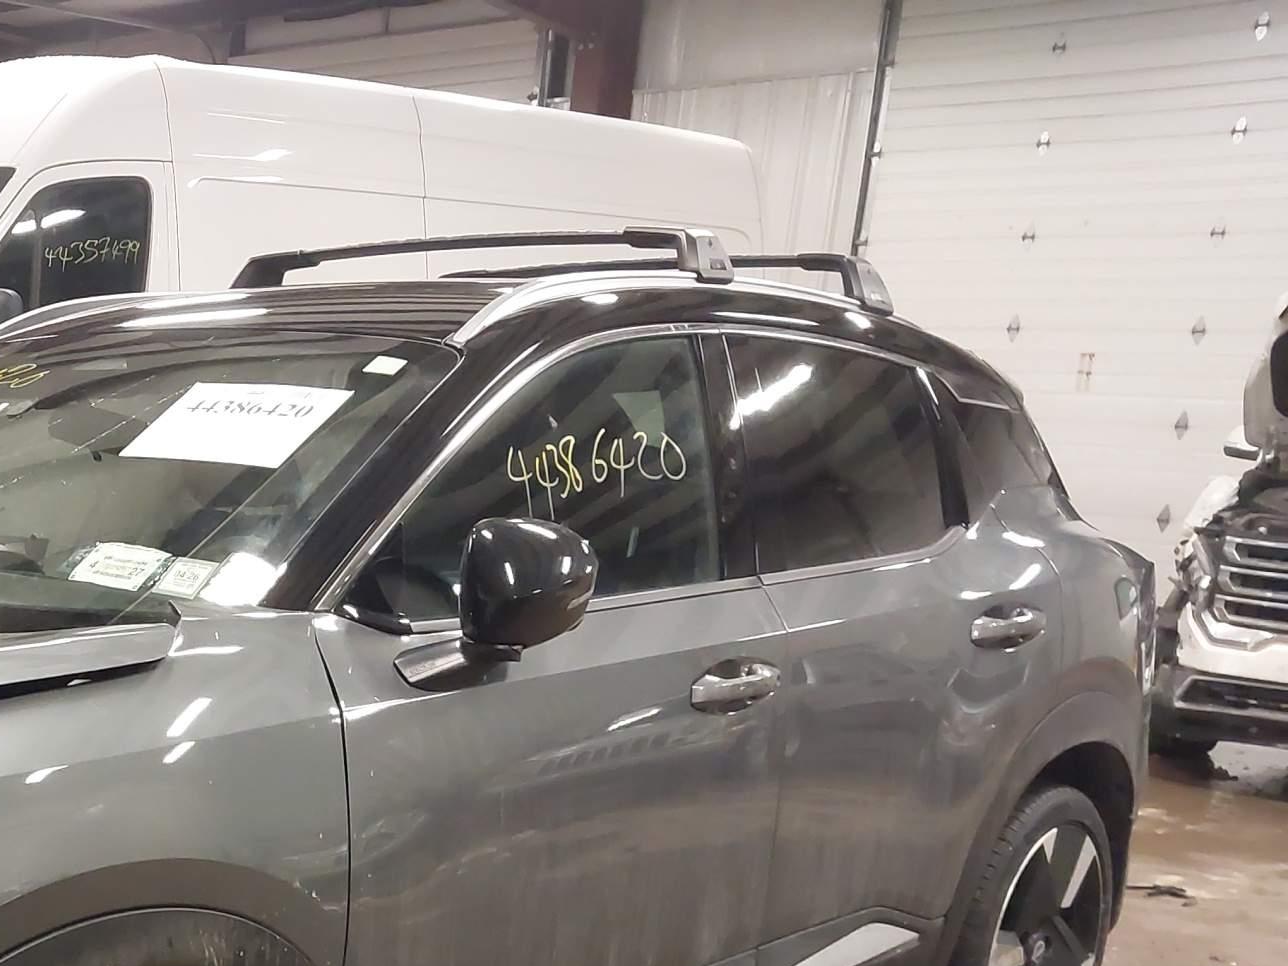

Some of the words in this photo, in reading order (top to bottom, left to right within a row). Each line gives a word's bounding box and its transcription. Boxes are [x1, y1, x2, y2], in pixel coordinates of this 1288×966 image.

[45, 236, 140, 272] 44357499
[187, 400, 314, 417] 44386420
[507, 428, 686, 520] 44386420
